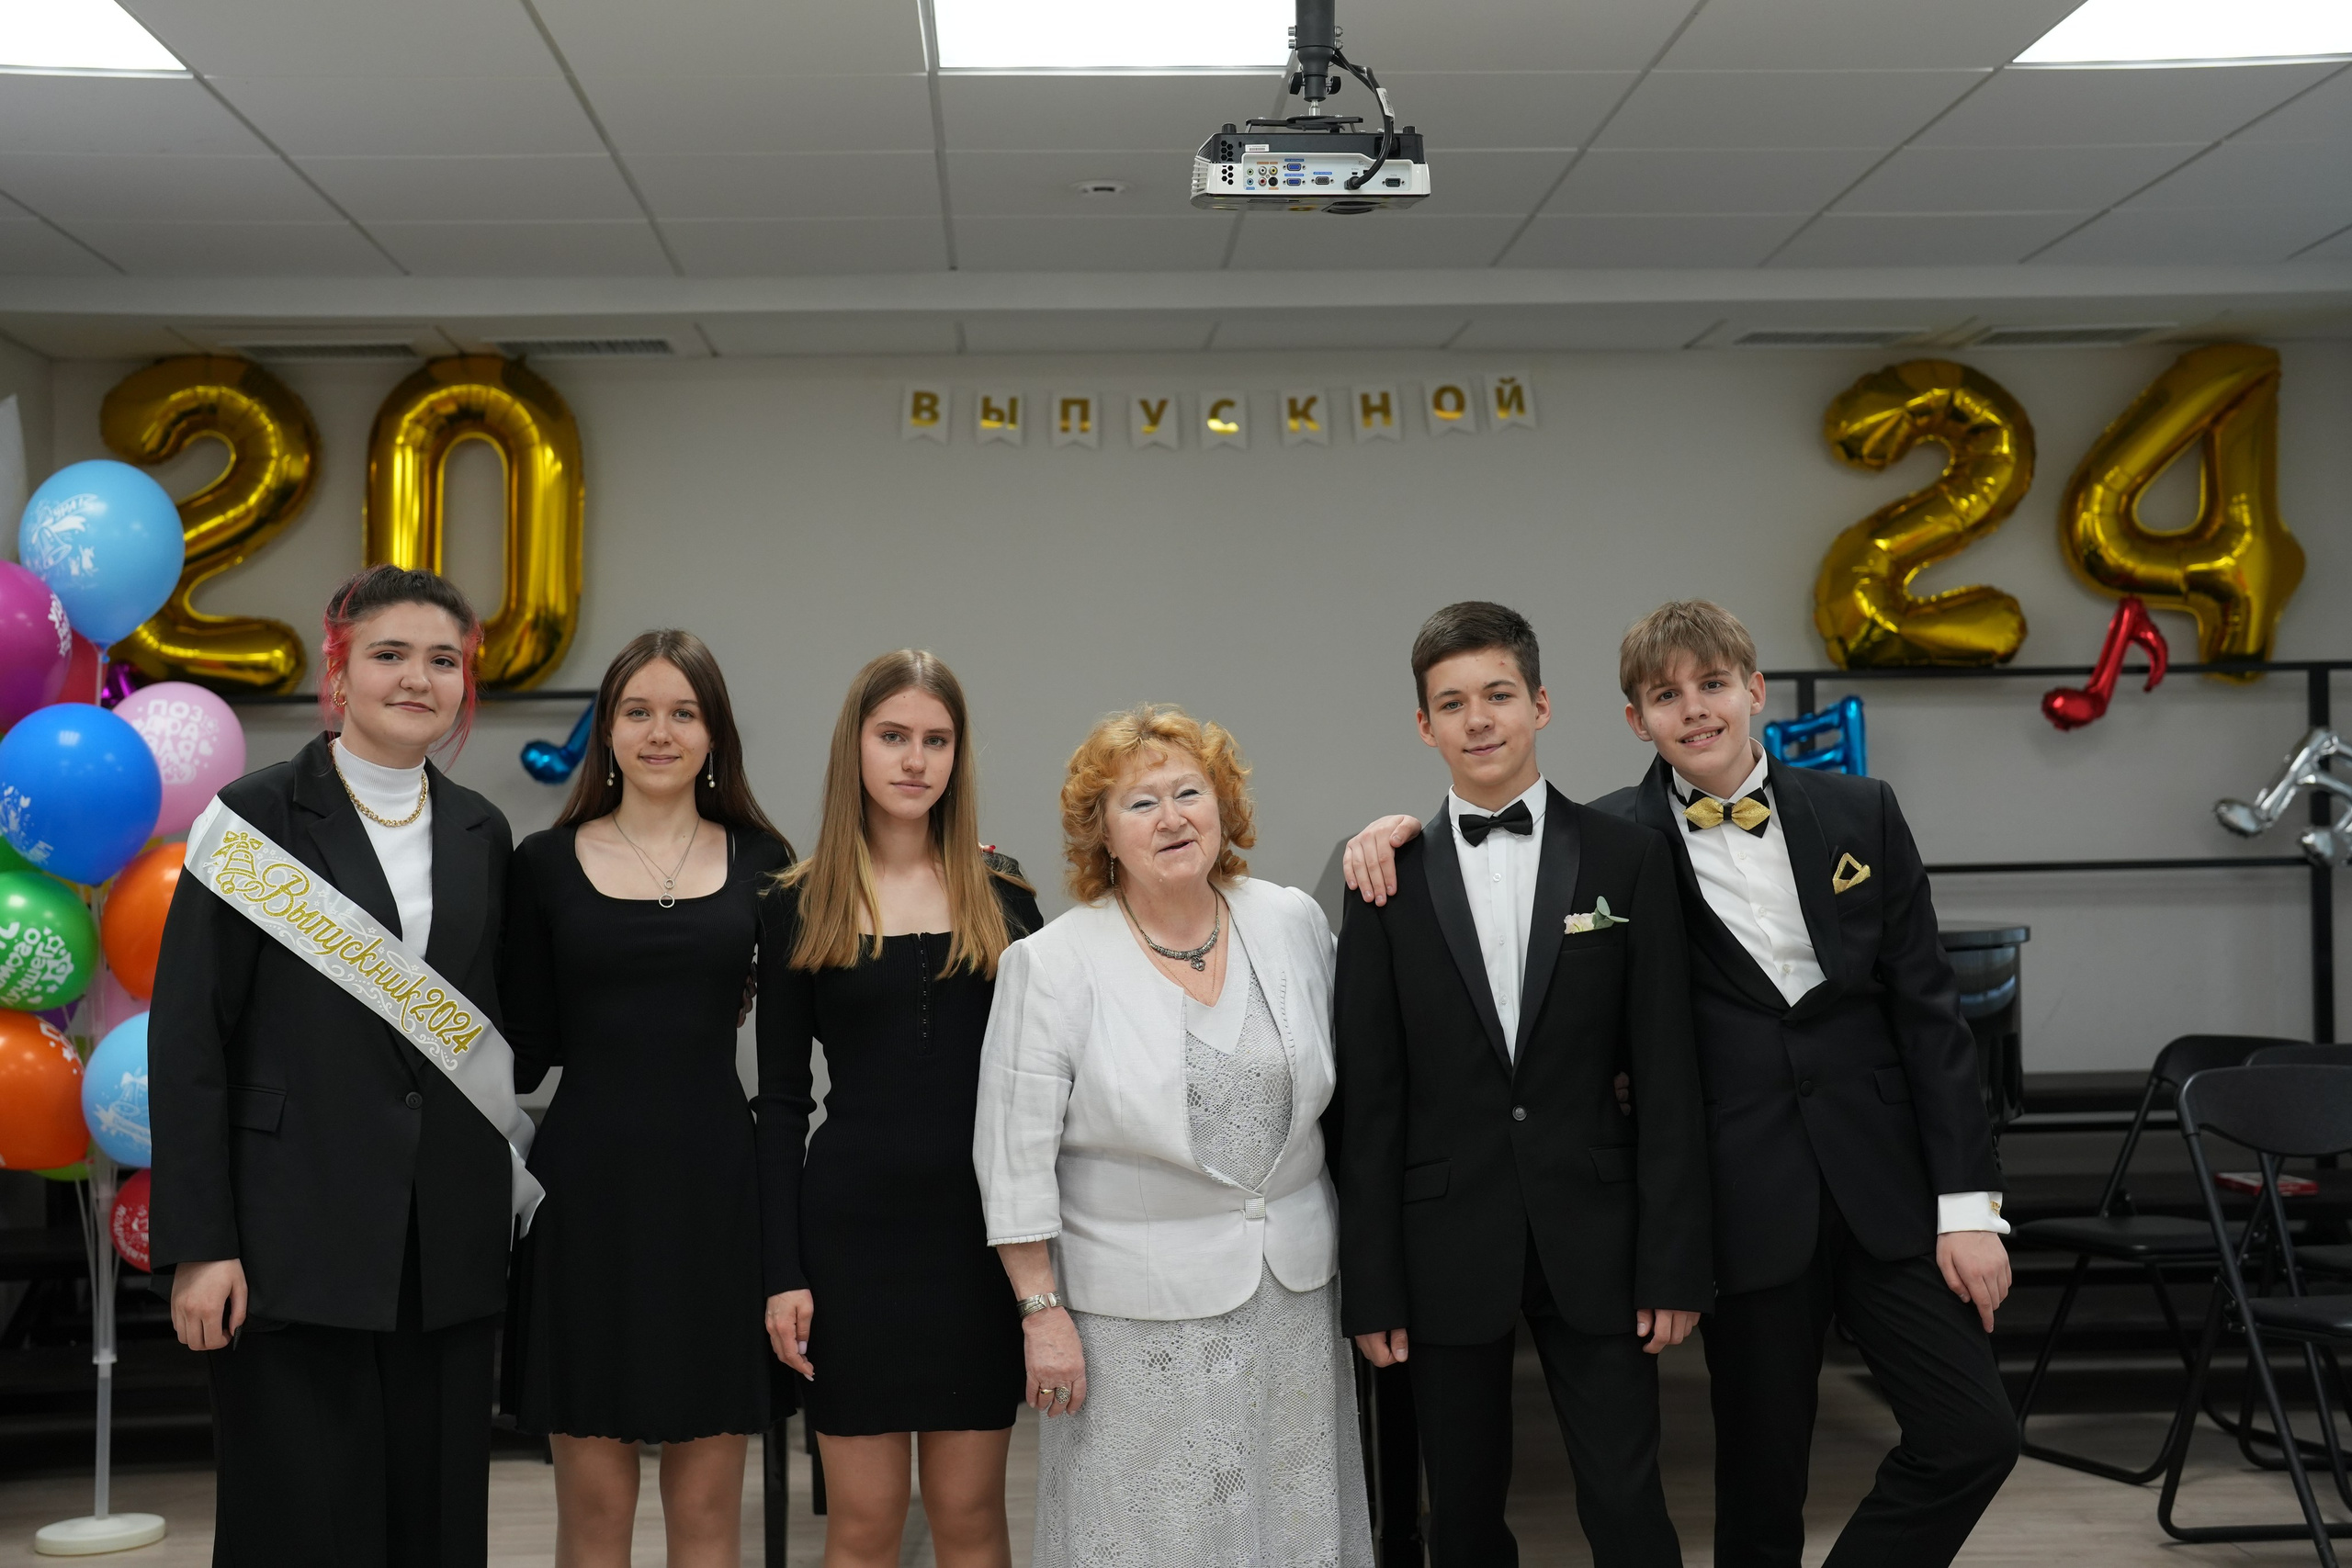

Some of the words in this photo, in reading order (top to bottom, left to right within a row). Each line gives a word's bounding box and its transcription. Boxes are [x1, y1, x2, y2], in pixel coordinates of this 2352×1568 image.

[911, 377, 1524, 434] ВЫПУСКНОЙ
[253, 863, 428, 1032] Выпускник
[410, 987, 483, 1055] 2024
